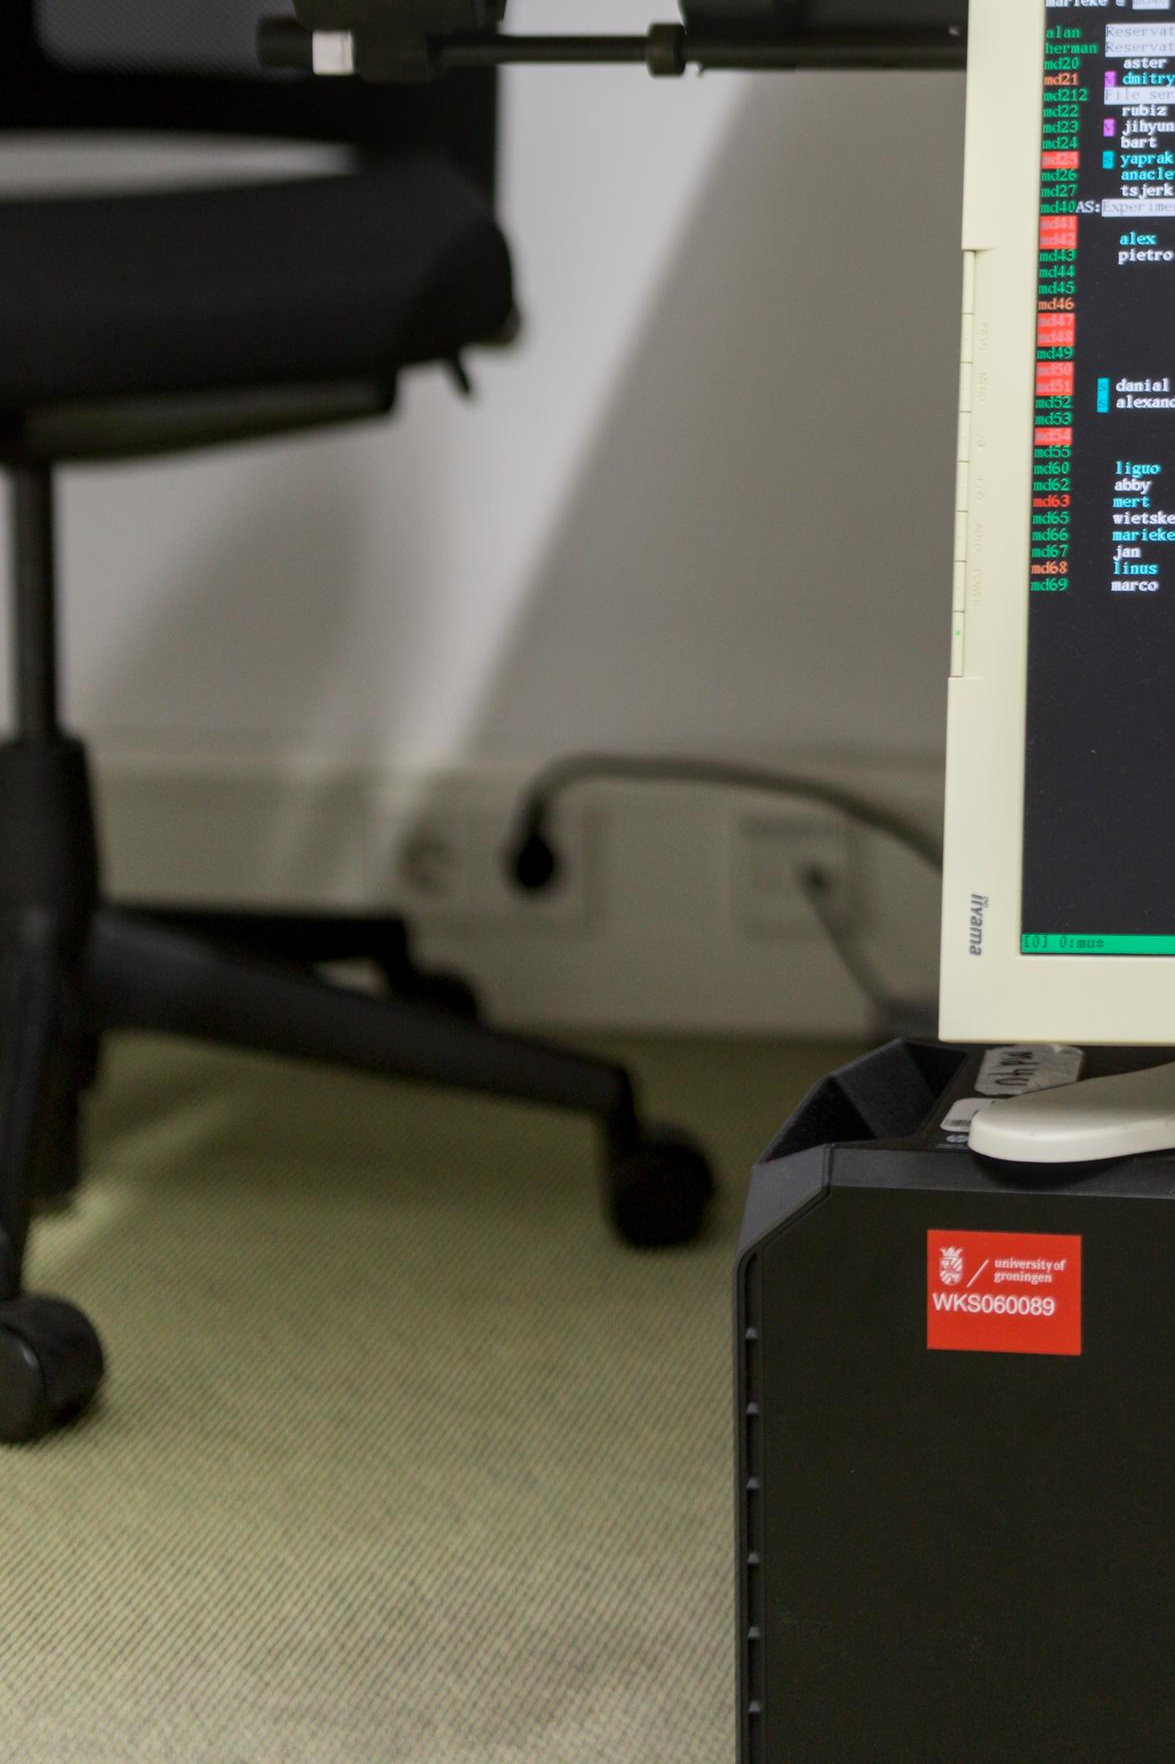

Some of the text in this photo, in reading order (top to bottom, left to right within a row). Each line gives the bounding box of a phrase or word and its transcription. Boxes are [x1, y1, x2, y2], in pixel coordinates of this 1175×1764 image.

[1045, 25, 1081, 37] alan
[1044, 40, 1098, 53] herman
[1044, 56, 1080, 69] md20
[1123, 55, 1168, 68] aster
[1044, 72, 1080, 85] md21
[1122, 71, 1175, 87] dmitry
[1043, 88, 1088, 101] md212
[1105, 87, 1141, 100] File
[1043, 104, 1079, 117] md22
[1122, 103, 1167, 116] rubiz
[1043, 120, 1079, 133] md23
[1121, 119, 1175, 135] jihyun
[1042, 136, 1078, 149] md24
[1121, 135, 1157, 148] bart
[1121, 151, 1175, 167] yaprak
[1041, 168, 1078, 181] md26
[1041, 184, 1077, 197] md27
[1120, 183, 1174, 199] tsjerk
[1119, 232, 1156, 245] alex
[1039, 249, 1076, 261] md43
[1119, 248, 1173, 264] pietro
[1039, 265, 1075, 278] md44
[1039, 281, 1075, 294] md45
[1038, 298, 1075, 310] md46
[1037, 347, 1074, 359] md49
[1036, 396, 1072, 409] md52
[1035, 412, 1072, 425] md53
[1034, 445, 1071, 458] md55
[1034, 462, 1071, 475] md60
[1114, 462, 1160, 477] liguo
[1034, 479, 1071, 491] md62
[1114, 478, 1151, 494] abby
[1033, 495, 1070, 508] md63
[1114, 495, 1151, 508] mert
[1033, 512, 1070, 525] md65
[1032, 529, 1069, 541] md66
[1032, 545, 1069, 558] md67
[1113, 545, 1141, 561] jan
[1032, 562, 1069, 575] md68
[1112, 562, 1159, 575] linus
[1031, 579, 1068, 592] md69
[1112, 582, 1158, 592] marco
[969, 893, 989, 957] iiyama
[994, 1258, 1066, 1272] university of
[993, 1270, 1053, 1285] groningen
[932, 1292, 1055, 1316] WKS060089
